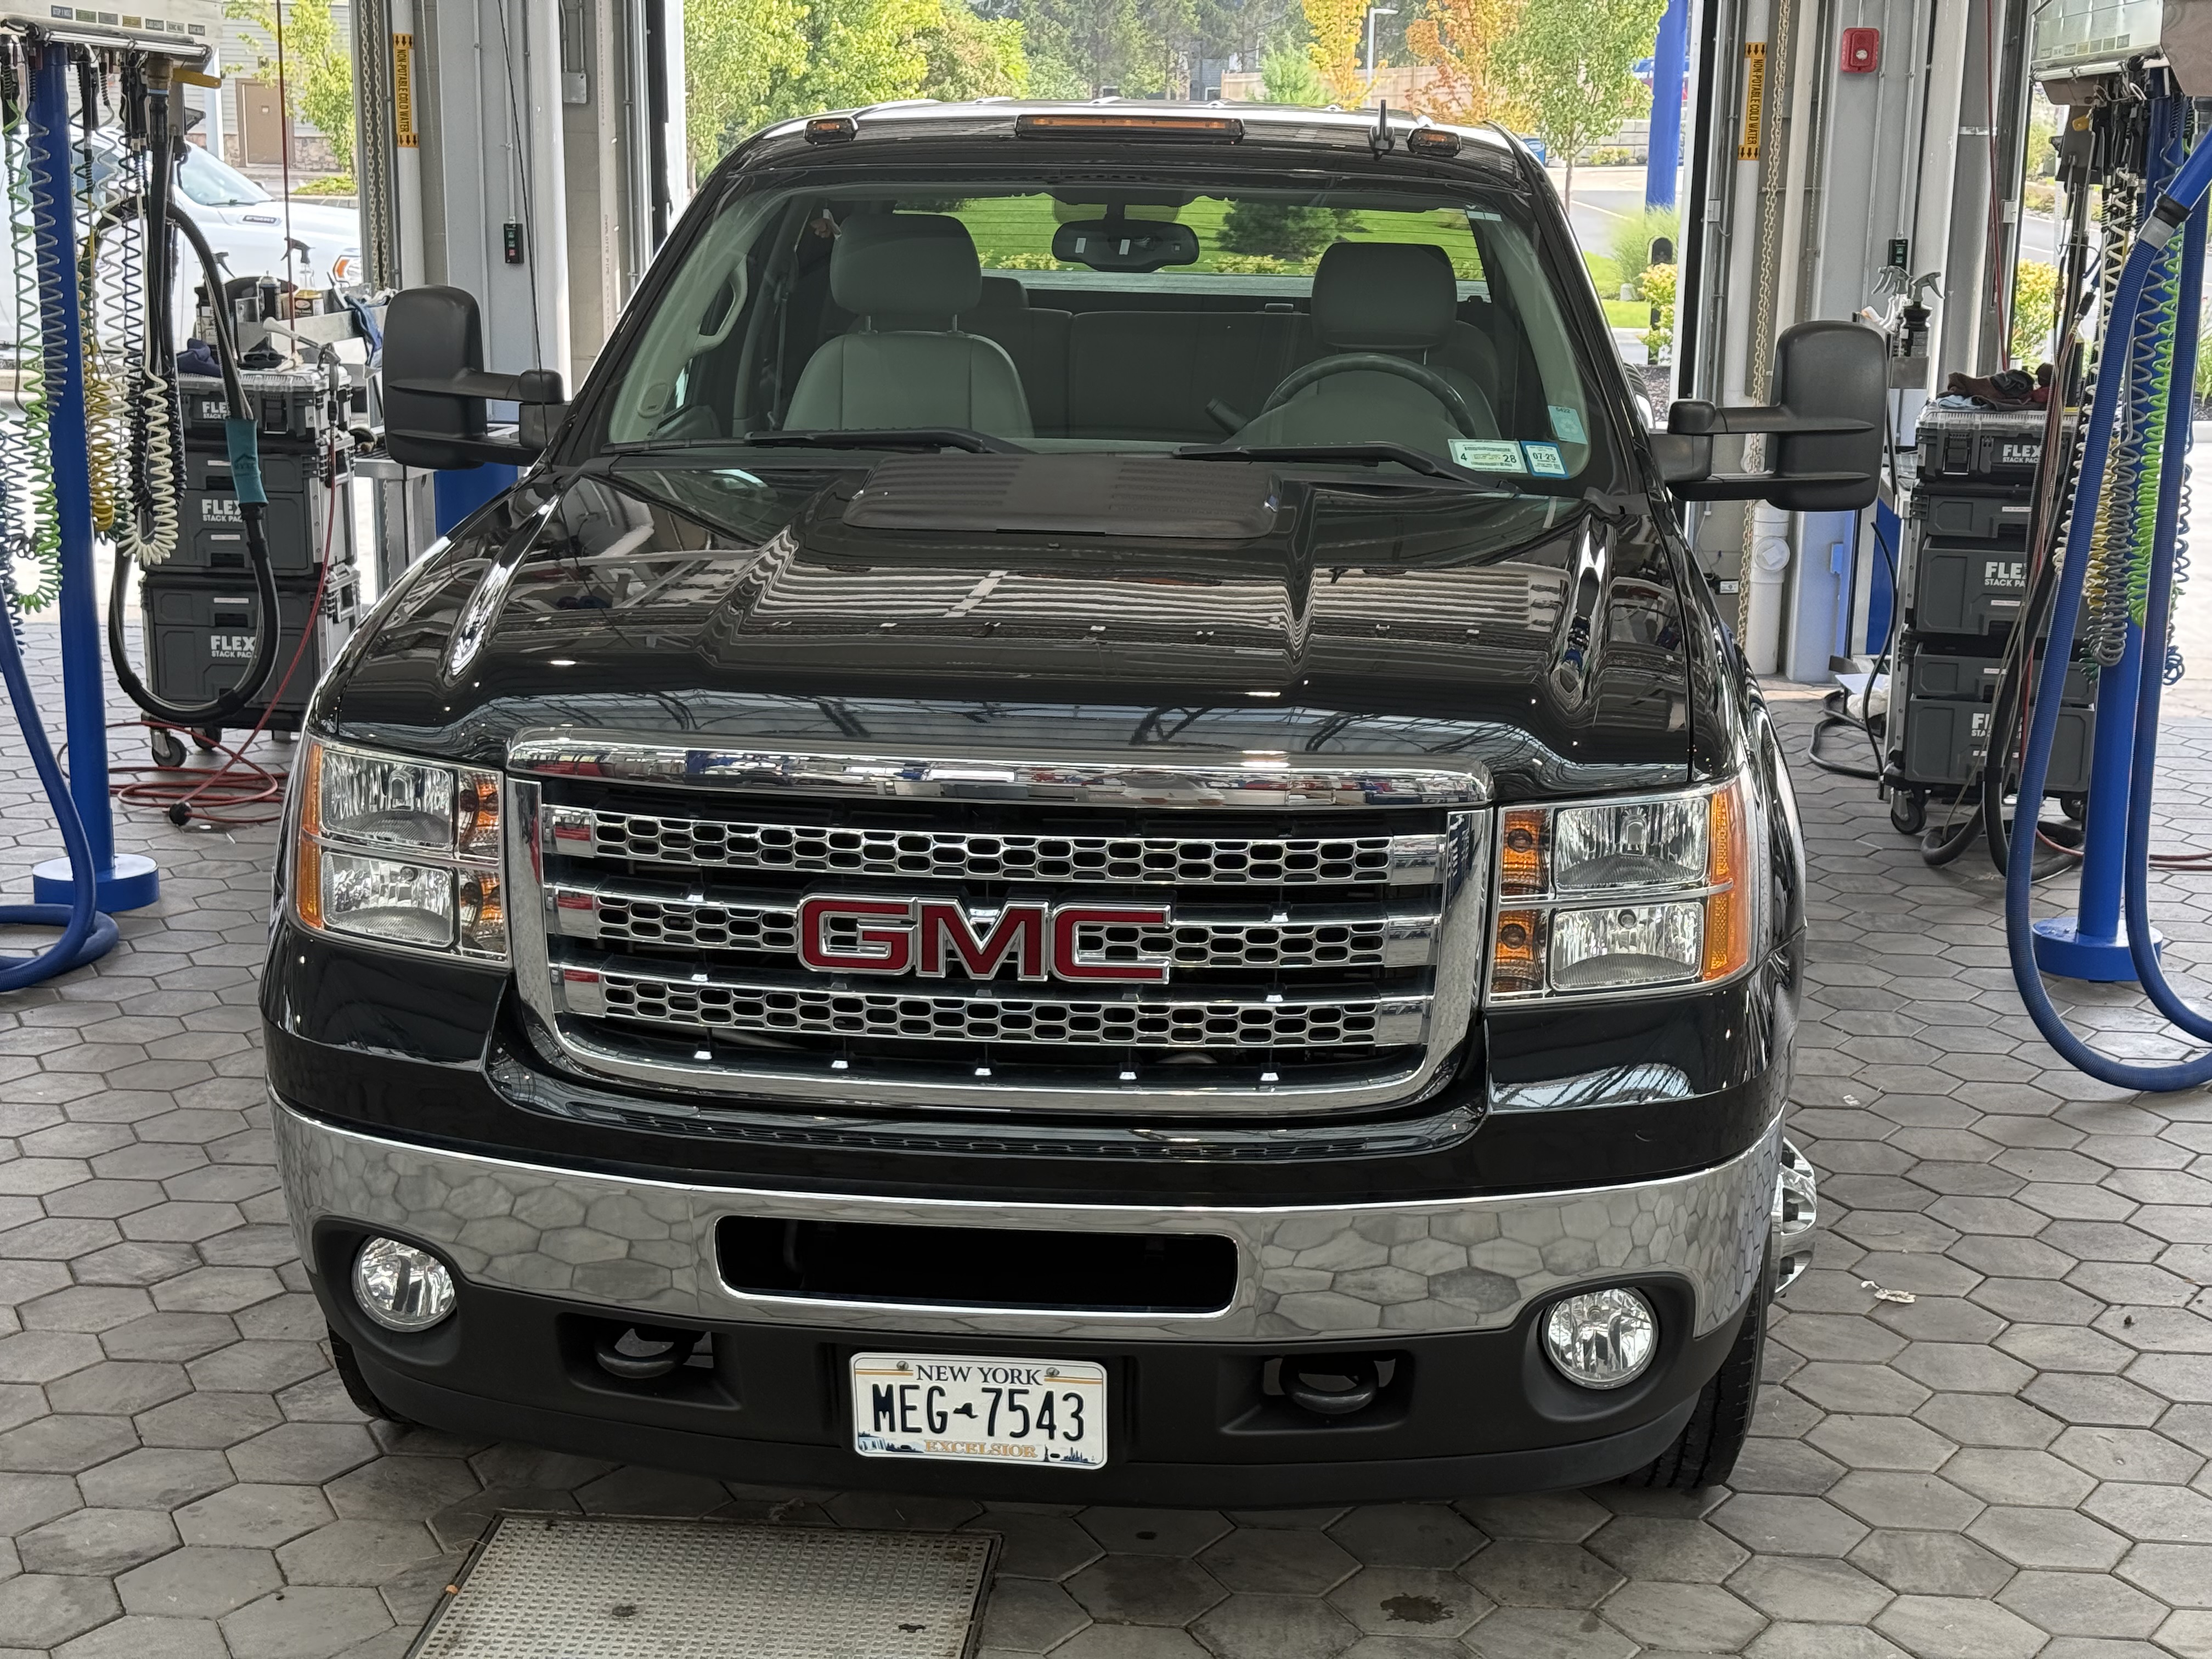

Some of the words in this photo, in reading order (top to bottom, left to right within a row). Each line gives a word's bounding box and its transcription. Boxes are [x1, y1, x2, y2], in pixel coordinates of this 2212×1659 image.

[397, 49, 408, 92] NON-POTABLE
[1751, 59, 1763, 103] NON-POTABLE
[398, 93, 409, 109] COLD
[399, 111, 409, 133] WATER
[1749, 104, 1760, 121] COLD
[1747, 122, 1758, 145] WATER
[202, 401, 228, 413] FLE
[1502, 454, 1517, 463] 28
[1984, 578, 2013, 587] STACK
[2015, 579, 2026, 588] PA
[211, 635, 256, 651] FLEX
[797, 893, 1171, 985] GMC
[916, 1364, 973, 1383] NEW
[977, 1366, 1043, 1386] YORK
[872, 1383, 949, 1434] MEG
[981, 1387, 1085, 1441] 7543
[924, 1439, 1039, 1458] EXCELSIOR
